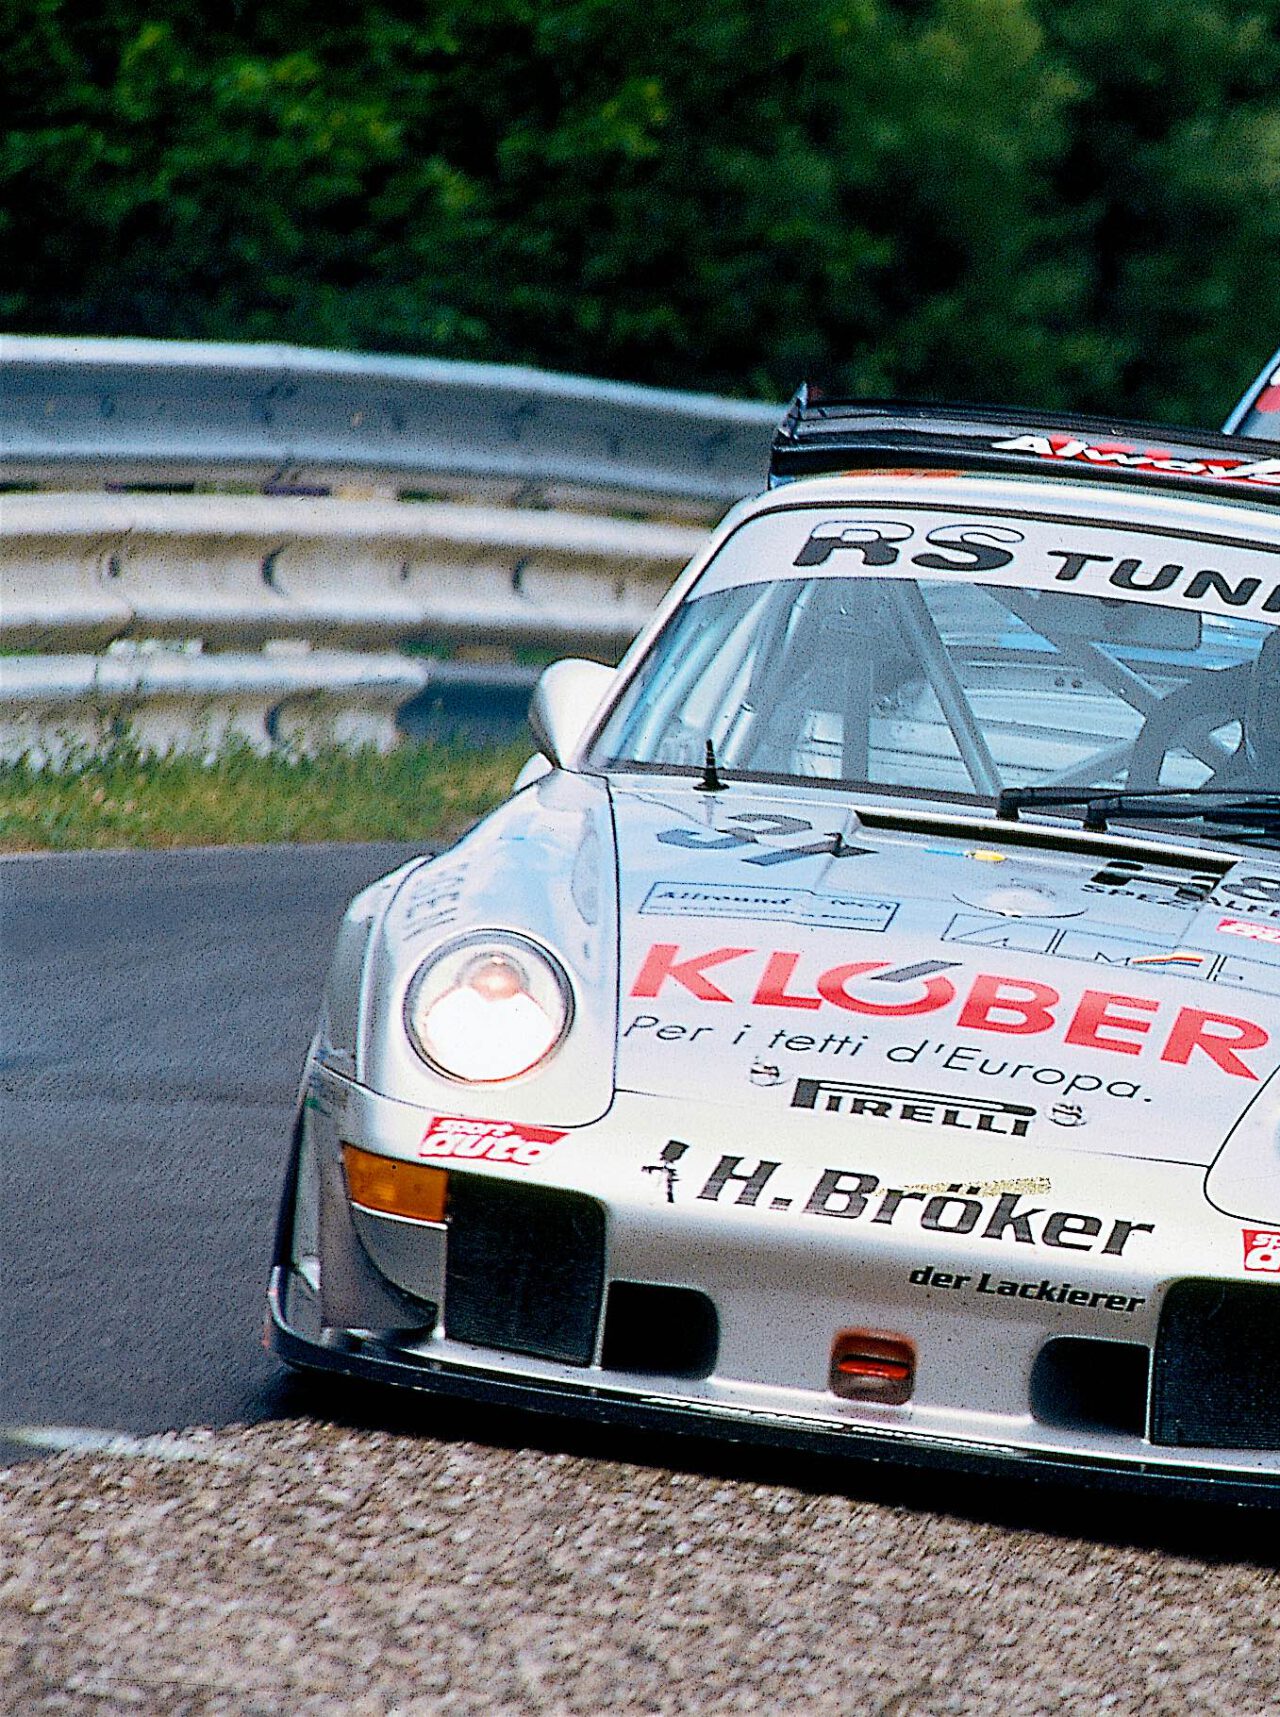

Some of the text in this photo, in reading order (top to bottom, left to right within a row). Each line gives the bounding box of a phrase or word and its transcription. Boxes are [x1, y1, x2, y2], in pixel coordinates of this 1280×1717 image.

[792, 520, 1025, 572] RS
[623, 1014, 1153, 1104] Per i tetti d'Europa.
[789, 1077, 1038, 1138] PIRELLI
[421, 1131, 555, 1165] auto
[907, 1265, 1147, 1313] der Lackierer
